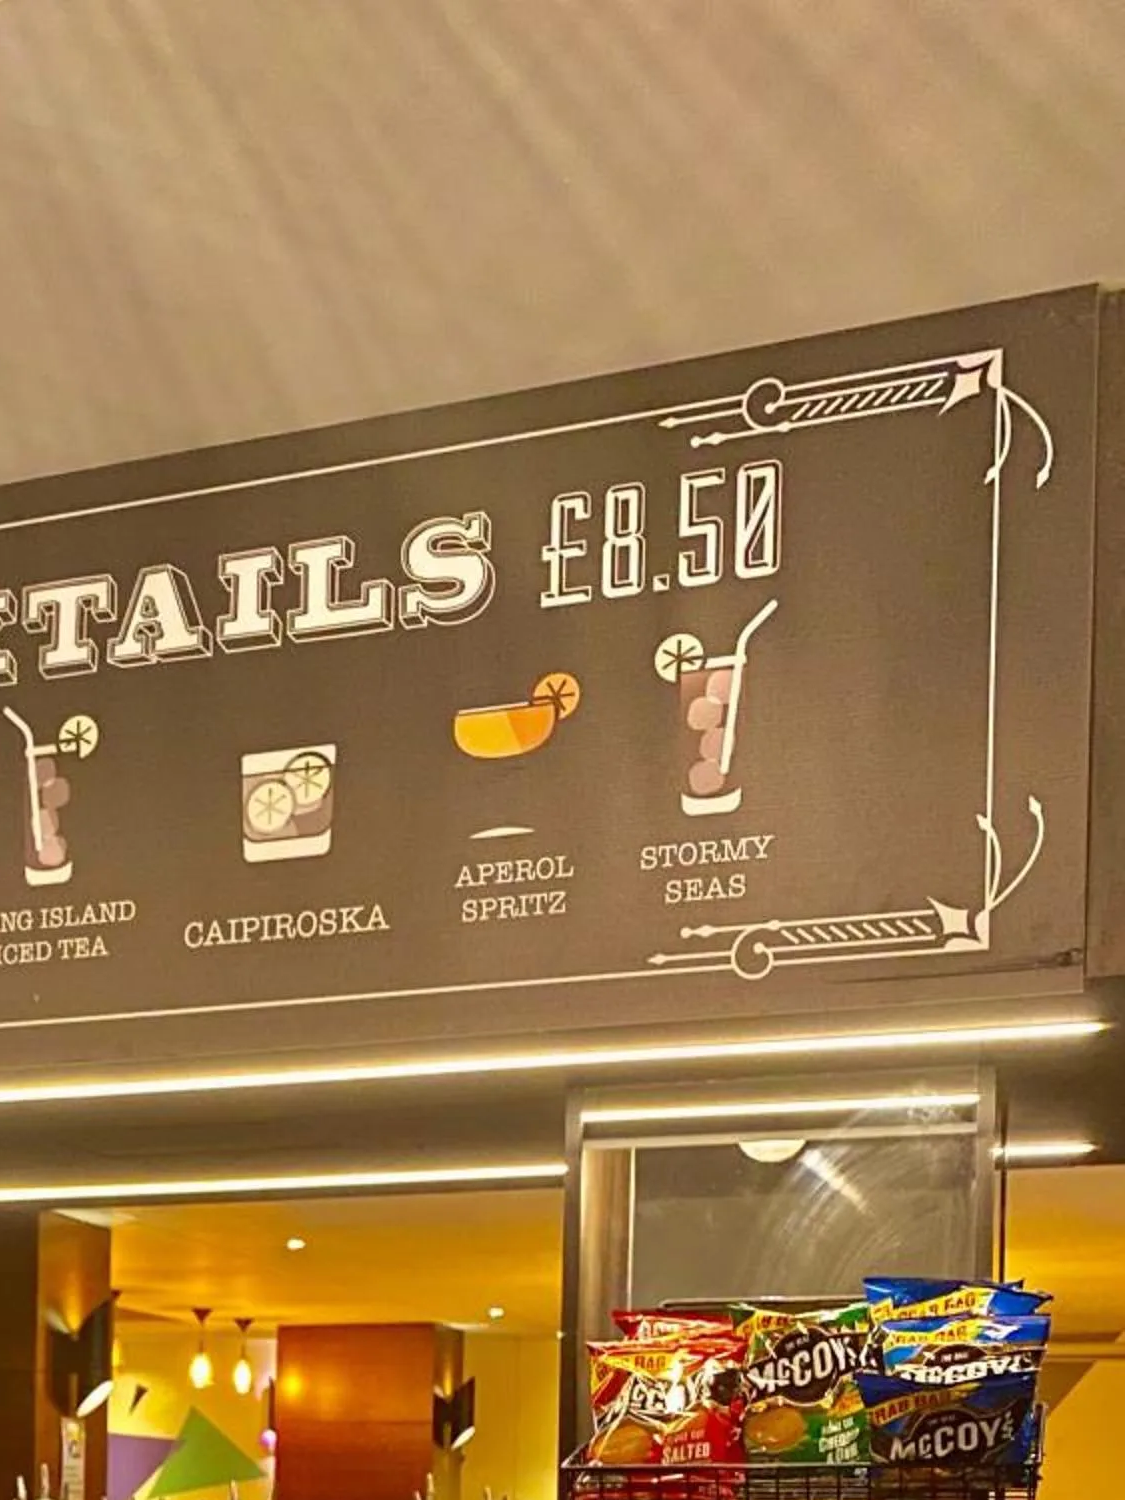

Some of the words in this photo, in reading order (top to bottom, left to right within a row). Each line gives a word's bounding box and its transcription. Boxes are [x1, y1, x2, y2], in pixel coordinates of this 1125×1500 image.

[540, 460, 783, 608] £8.50
[639, 835, 775, 872] STORMY
[454, 855, 574, 890] APEROL
[664, 874, 747, 905] SEAS
[39, 899, 136, 929] ISLAND
[461, 891, 567, 923] SPRITZ
[184, 903, 390, 951] CAIPIROSKA
[56, 935, 108, 961] TEA
[662, 1441, 711, 1465] SALTED
